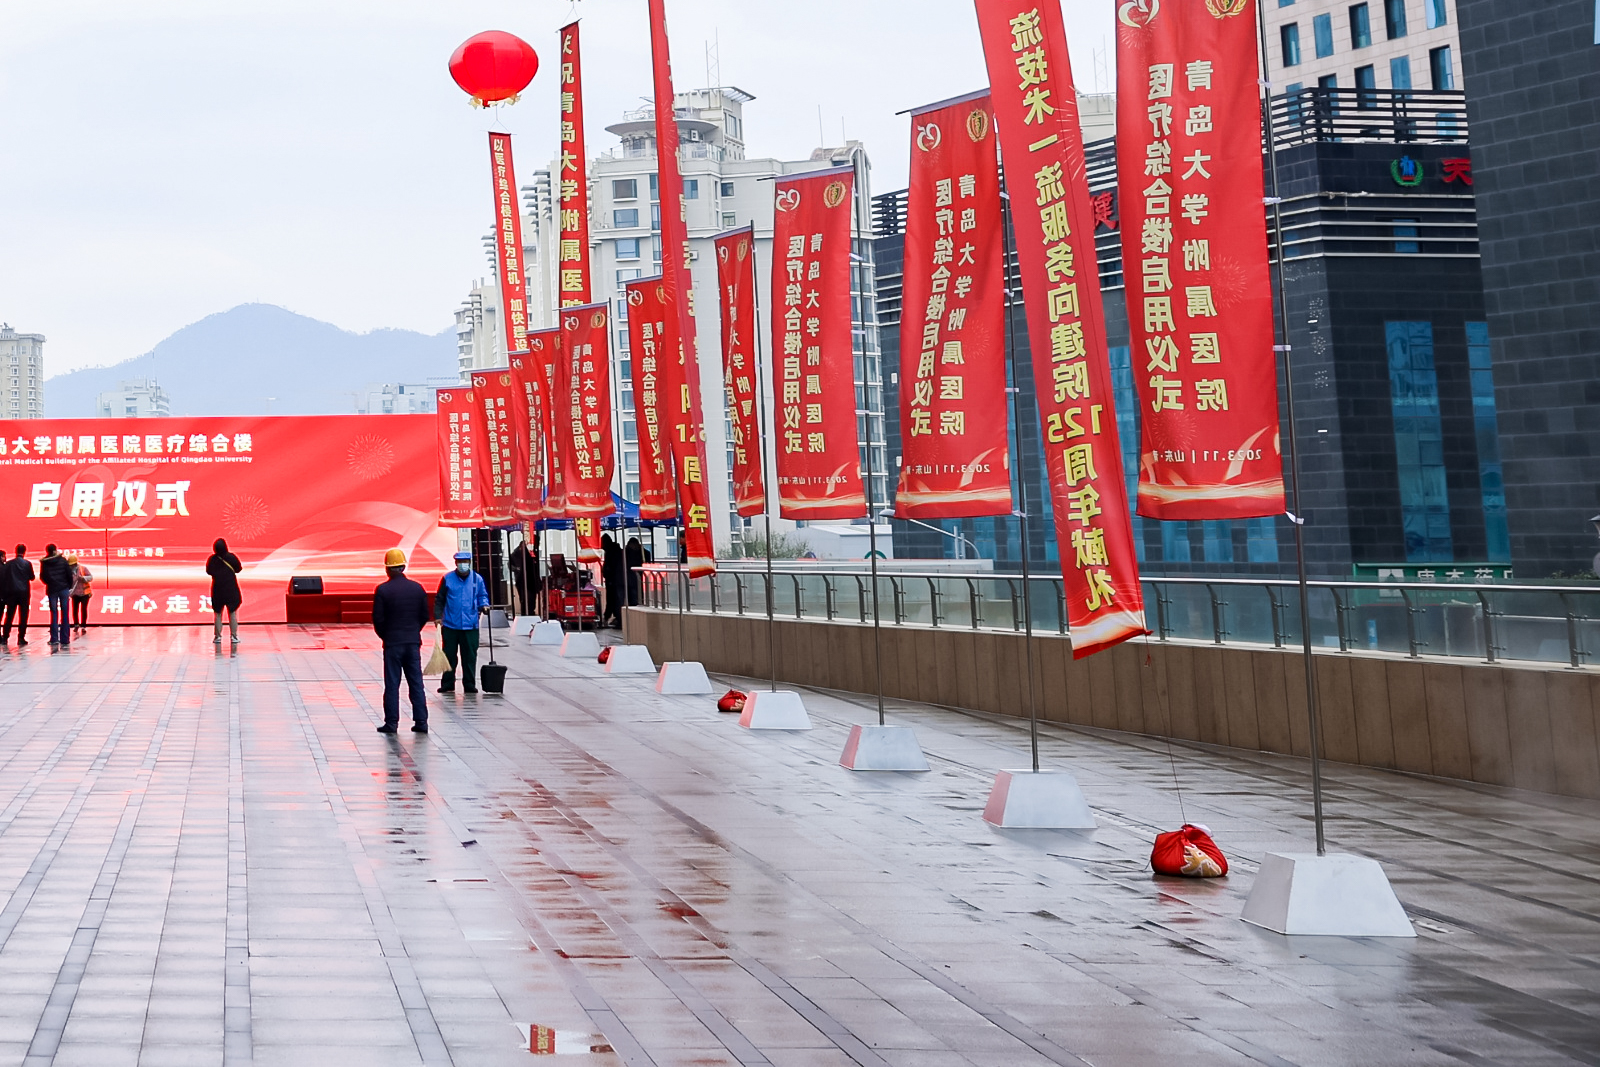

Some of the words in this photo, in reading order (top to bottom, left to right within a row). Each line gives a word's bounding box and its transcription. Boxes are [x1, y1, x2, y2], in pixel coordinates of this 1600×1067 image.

[45, 458, 76, 466] Building
[138, 456, 169, 464] Hospital
[181, 456, 213, 464] Qingdao
[214, 456, 252, 464] University
[26, 480, 191, 518] 启用仪式
[117, 548, 165, 558] 山东·青岛
